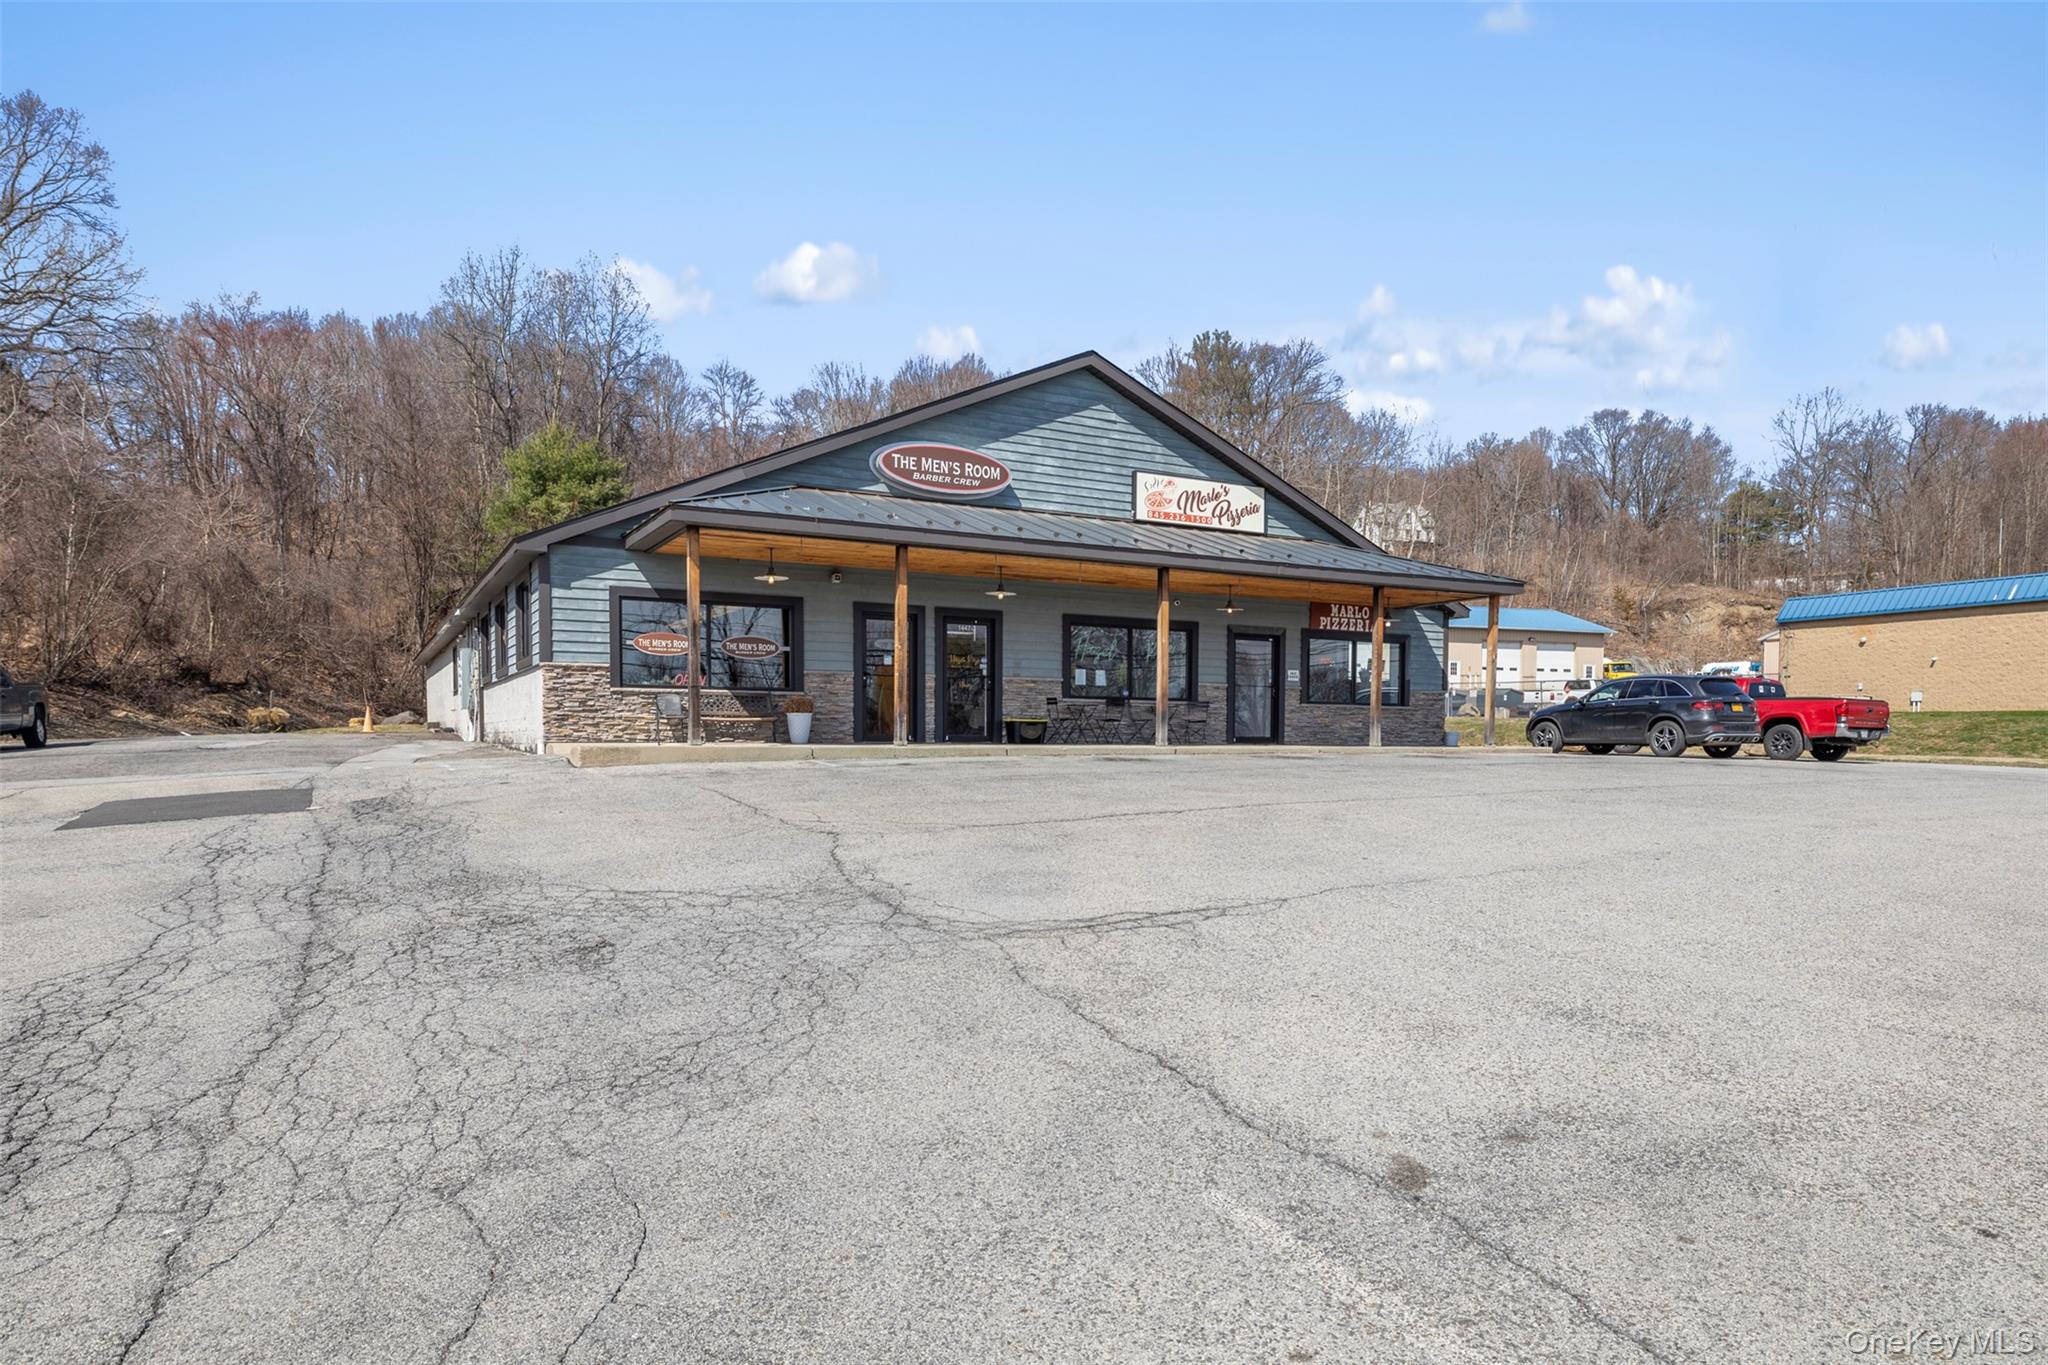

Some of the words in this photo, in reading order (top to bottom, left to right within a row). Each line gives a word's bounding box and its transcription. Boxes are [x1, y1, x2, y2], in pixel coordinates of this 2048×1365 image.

[891, 453, 917, 471] THE
[921, 457, 960, 475] MEN'S
[964, 463, 1001, 480] ROOM
[912, 472, 951, 483] BARBER
[953, 477, 981, 487] CREW
[1176, 484, 1230, 515] Marlo's
[1211, 499, 1261, 527] Pizzeria
[1330, 604, 1370, 619] MARLO
[638, 638, 651, 647] THE
[652, 639, 672, 648] MEN'S
[725, 642, 737, 650] THE
[758, 643, 776, 652] ROOM
[674, 672, 707, 687] OPN
